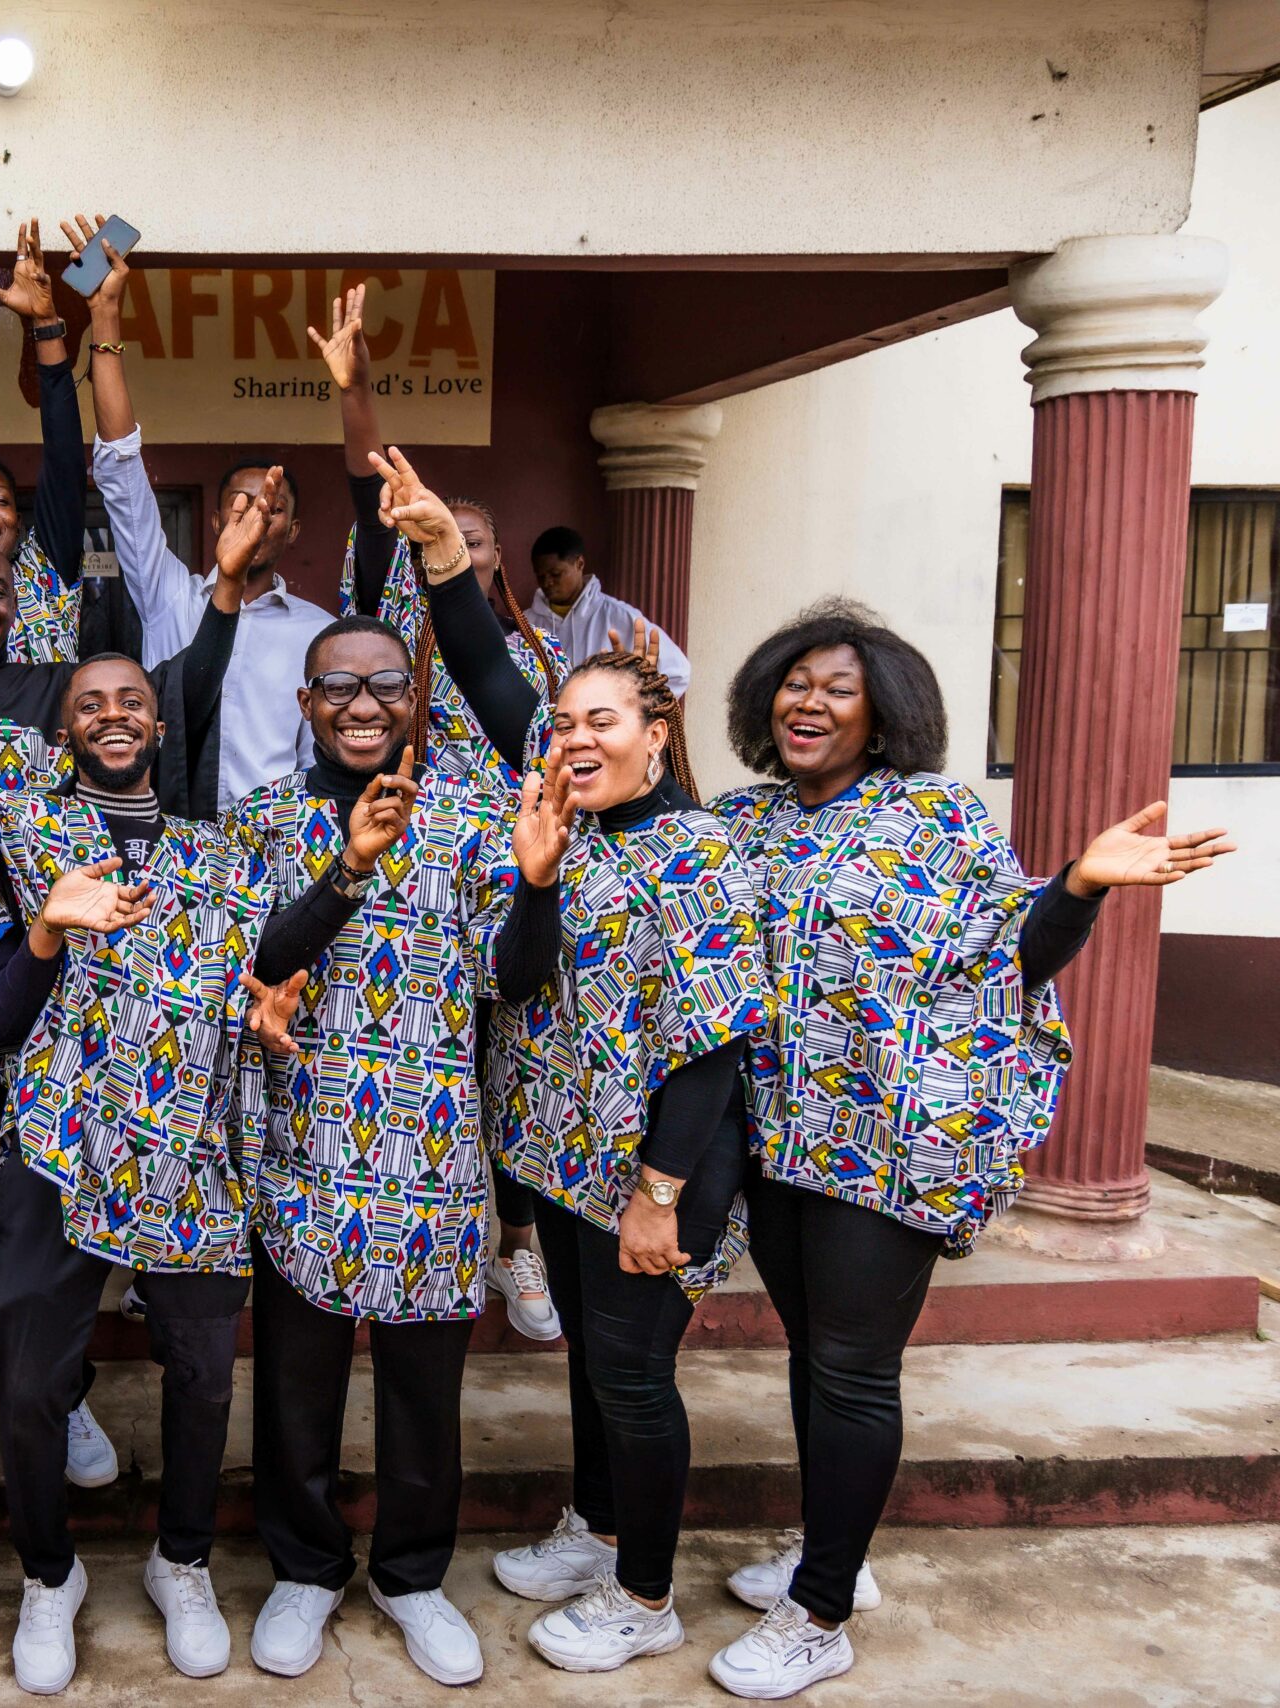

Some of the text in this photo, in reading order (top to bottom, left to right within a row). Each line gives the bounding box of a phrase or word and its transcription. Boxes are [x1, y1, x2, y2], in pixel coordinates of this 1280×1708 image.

[233, 374, 483, 401] Sharing d's Love
